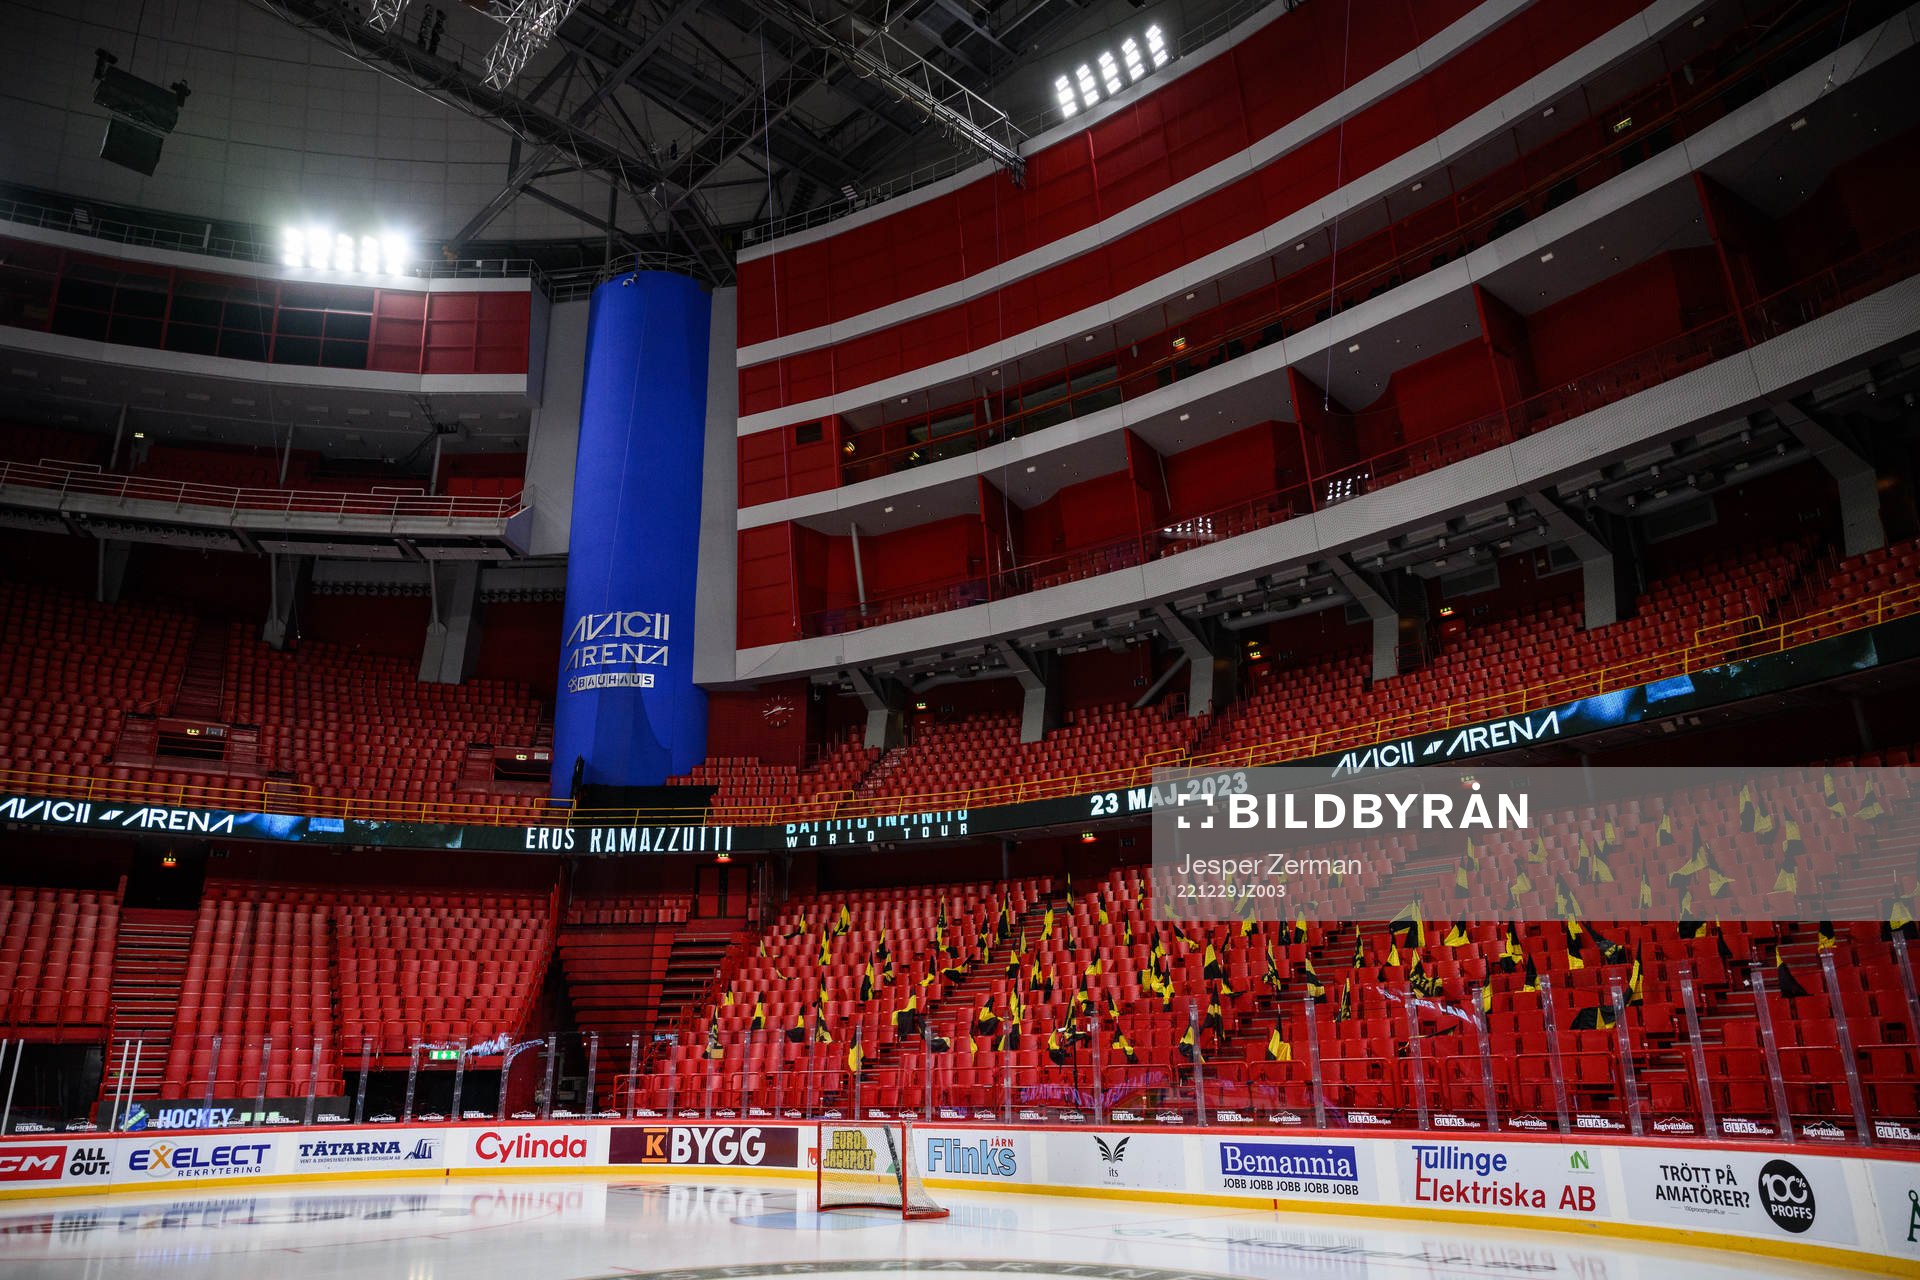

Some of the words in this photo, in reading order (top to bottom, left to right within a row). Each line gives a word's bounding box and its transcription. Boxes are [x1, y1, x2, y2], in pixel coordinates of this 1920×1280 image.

[566, 611, 670, 647] AVICII
[564, 643, 669, 672] ARENA
[577, 673, 655, 691] BAUHAUS
[1331, 741, 1415, 778] AVICII
[1446, 710, 1560, 756] ARENA
[1090, 793, 1119, 816] 23
[1128, 783, 1178, 811] MAJ
[1186, 771, 1248, 801] 2023
[0, 798, 91, 824] AVICII
[122, 808, 235, 834] ARENA
[525, 826, 575, 850] EROS
[786, 830, 875, 848] WORLD
[903, 823, 968, 840] TOUR
[157, 1107, 234, 1130] HOCKEY
[299, 1140, 401, 1157] TÄTARNA
[475, 1131, 587, 1163] Cylinda
[670, 1127, 766, 1165] BYGG
[833, 1130, 864, 1149] EURO
[72, 1148, 106, 1161] ALL
[129, 1144, 271, 1170] EXELECT
[823, 1148, 874, 1170] JACKPOT
[927, 1138, 1017, 1176] Flinks
[1223, 1145, 1353, 1178] Bemannia
[1412, 1145, 1508, 1176] Tullinge
[70, 1162, 110, 1176] OUT.
[178, 1166, 262, 1177] REKRYTERING
[1108, 1166, 1119, 1177] its
[1660, 1162, 1711, 1184] TRÖTT
[1716, 1164, 1738, 1186] PÅ
[1224, 1178, 1247, 1189] JOBB
[1250, 1179, 1273, 1190] JOBB
[1276, 1181, 1301, 1192] JOBB
[1304, 1182, 1329, 1193] JOBB
[1332, 1184, 1359, 1195] JOBB
[1416, 1178, 1546, 1208] Elektriska
[1558, 1184, 1596, 1212] AB
[1656, 1184, 1750, 1208] AMATÖRER?
[1771, 1204, 1813, 1220] PROFFS
